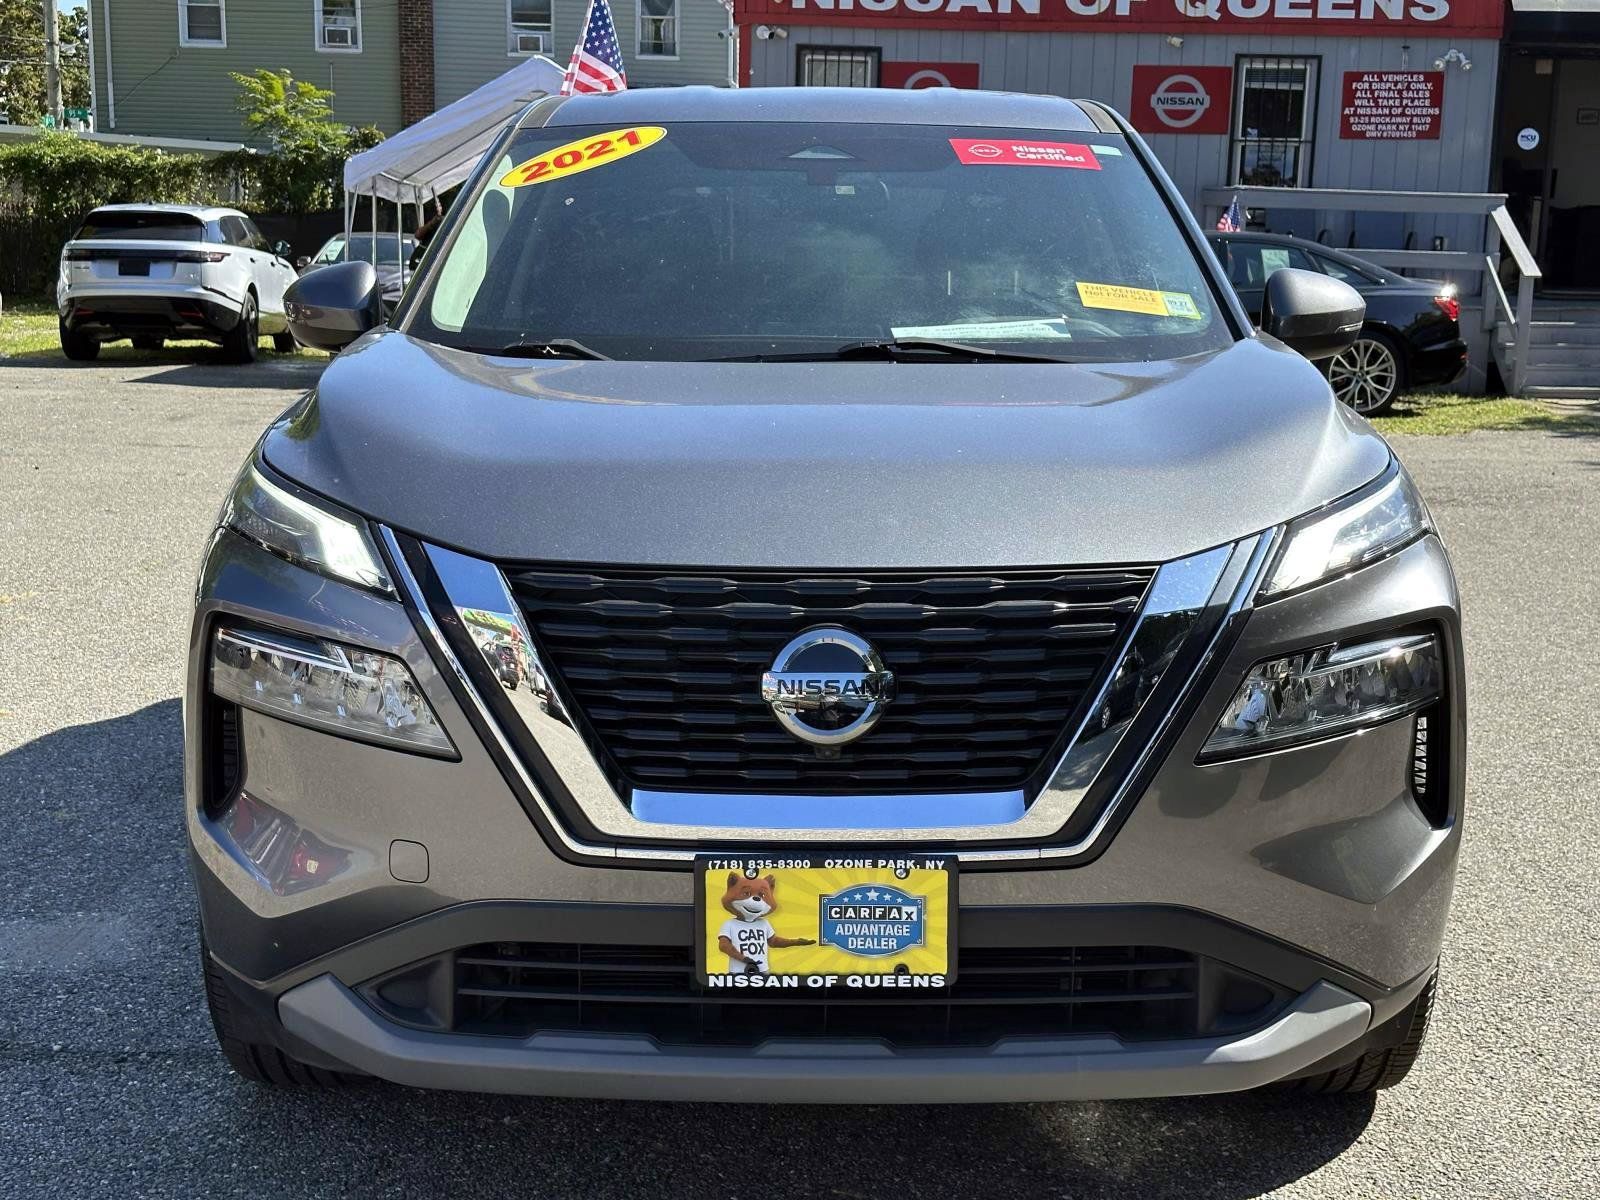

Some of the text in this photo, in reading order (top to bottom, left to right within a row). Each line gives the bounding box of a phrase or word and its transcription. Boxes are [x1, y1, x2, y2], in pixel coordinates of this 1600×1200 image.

[1363, 74, 1424, 82] ALL VEHICLES
[1352, 82, 1369, 90] FOR
[1355, 90, 1430, 98] ALL FINAL SALES
[1157, 97, 1204, 105] NISSAN
[1343, 107, 1440, 115] AT NISSAN OF QUEENS
[1012, 145, 1066, 155] Nissan
[521, 131, 642, 183] 2021
[1016, 152, 1086, 162] Certified
[777, 679, 880, 695] NISSAN
[708, 859, 811, 870] (718) 835-8300
[824, 859, 873, 869] OZONE
[925, 860, 945, 870] NY
[830, 907, 915, 921] CARFAX
[835, 923, 911, 936] ADVANTAGE
[738, 929, 765, 942] CAR
[739, 942, 765, 955] FOX
[848, 937, 897, 949] DEALER
[708, 975, 946, 988] NISSAN OF QUEENS
